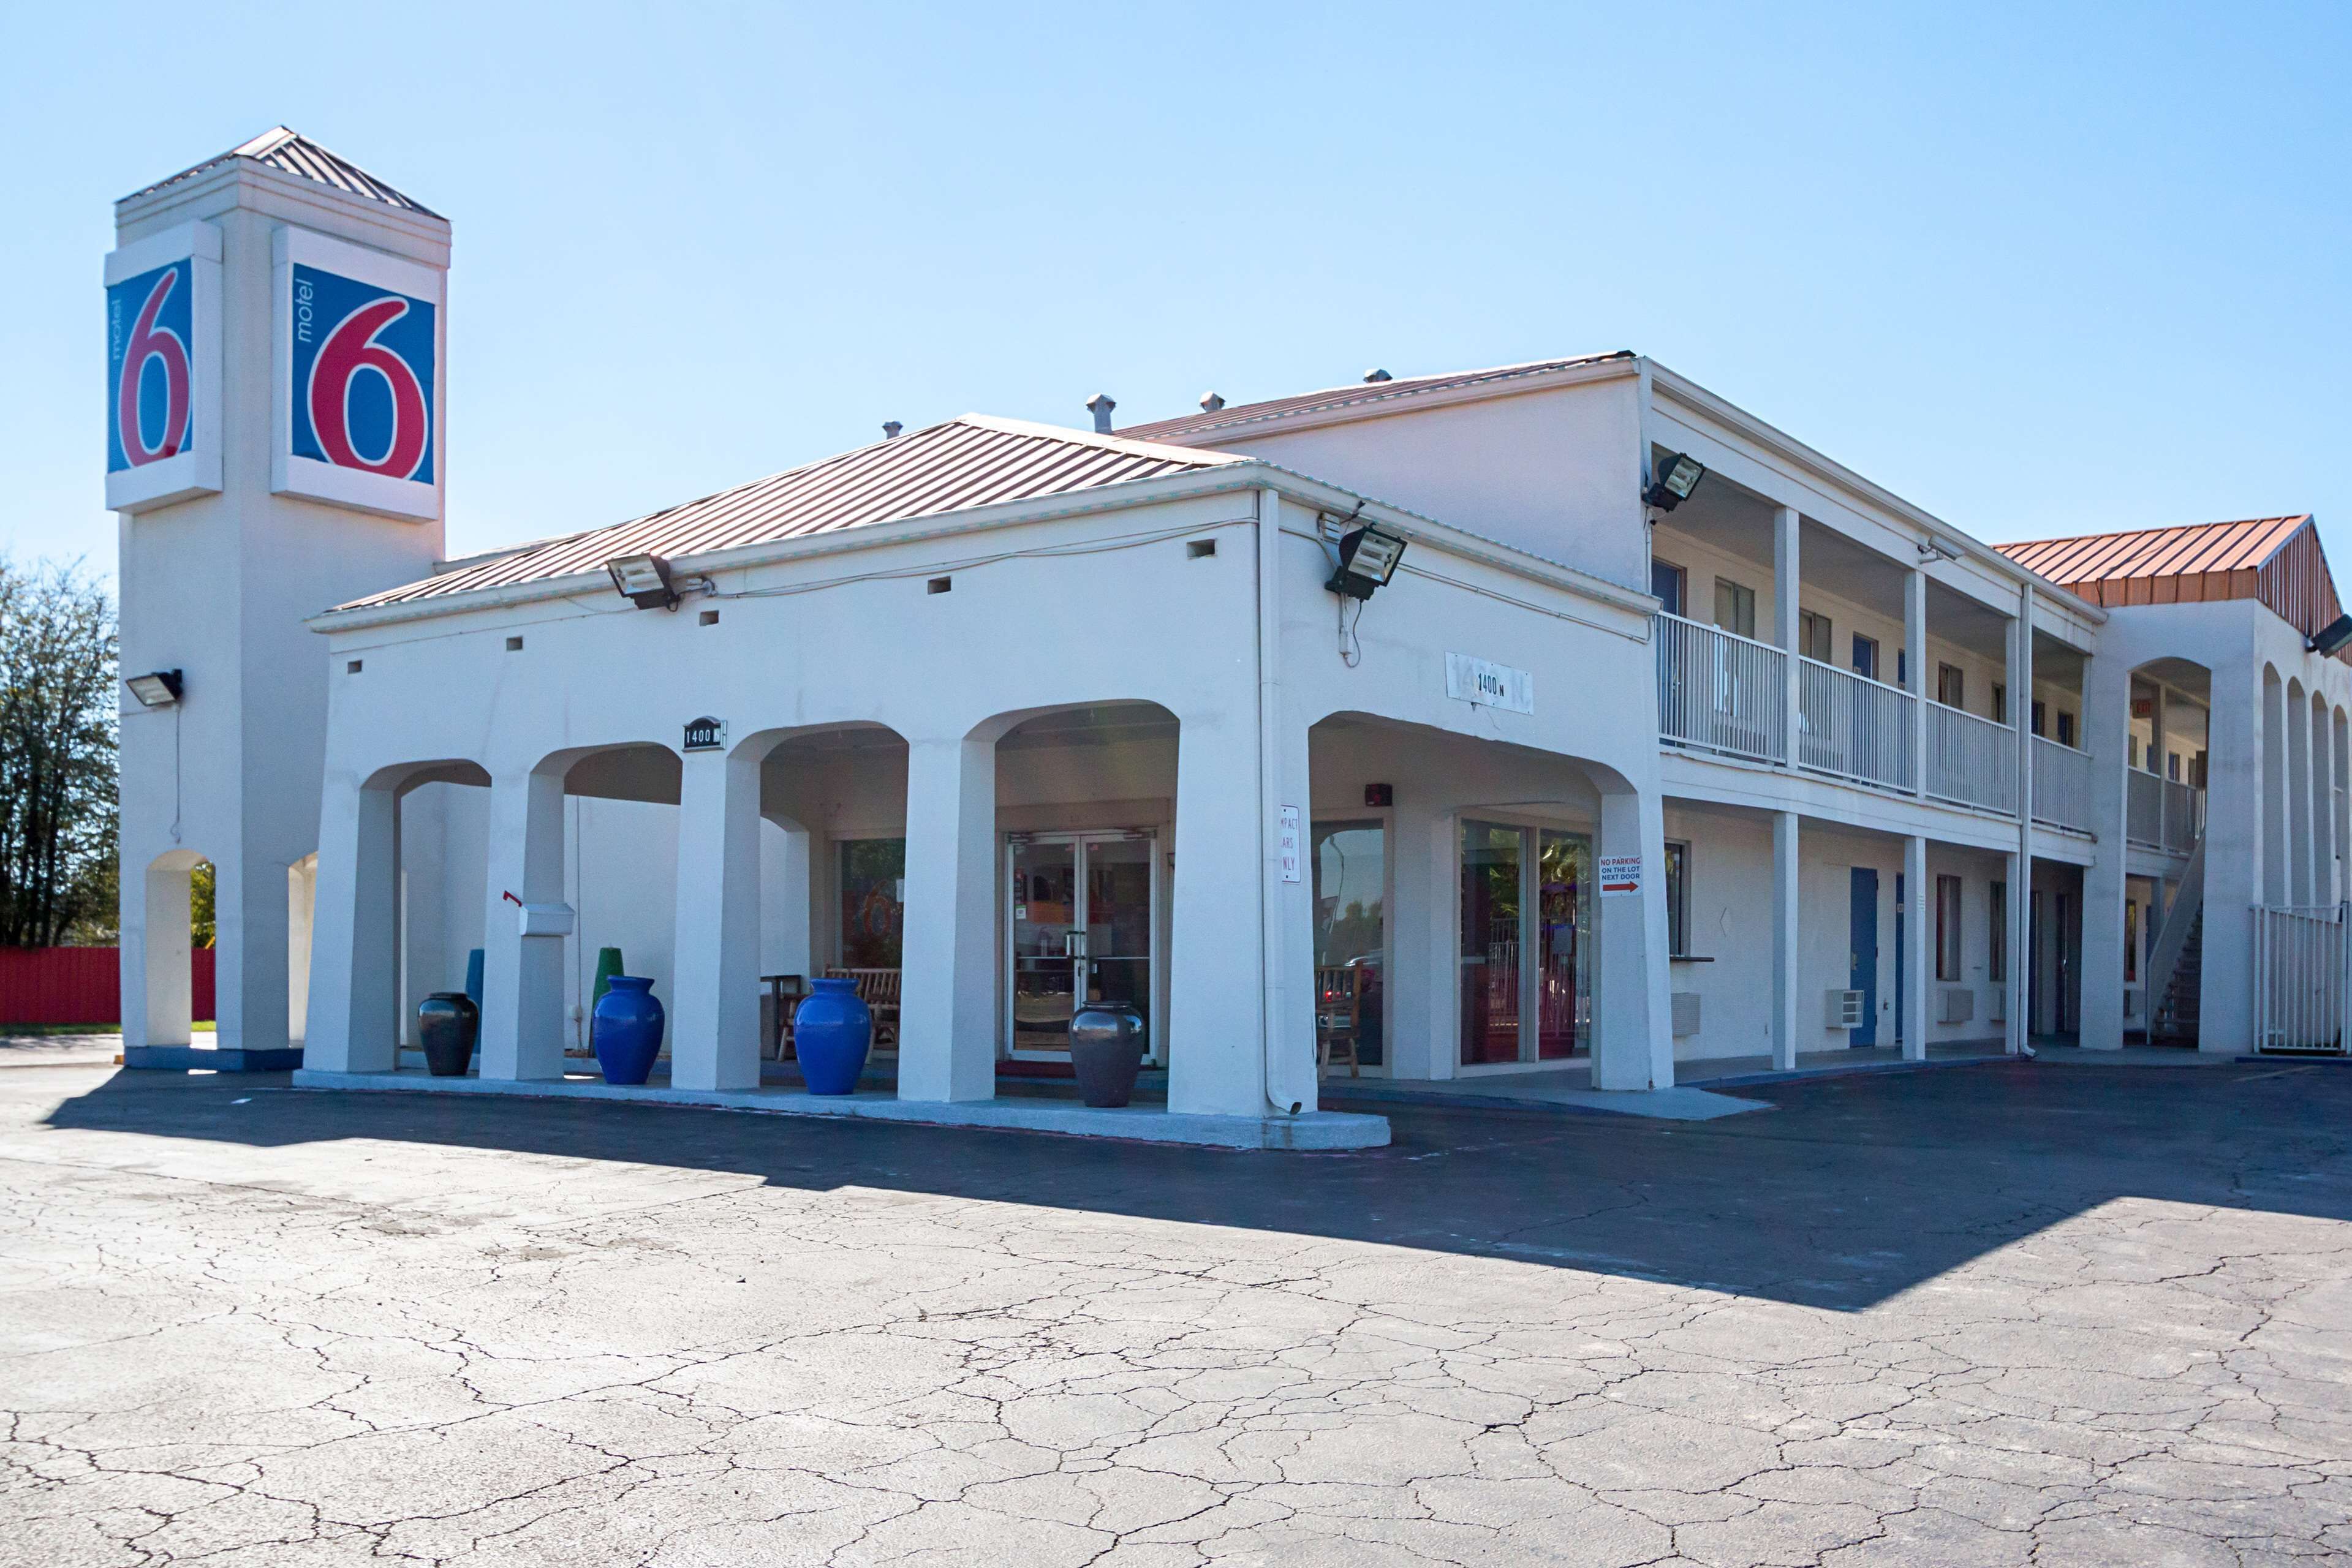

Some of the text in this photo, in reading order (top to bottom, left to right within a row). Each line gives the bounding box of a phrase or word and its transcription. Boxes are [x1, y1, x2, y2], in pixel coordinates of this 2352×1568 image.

[298, 279, 313, 342] motel
[113, 299, 121, 361] motel
[118, 267, 192, 467] 6
[307, 296, 428, 480] 6
[1478, 673, 1504, 696] 1400 N
[687, 729, 710, 743] 1400
[1280, 817, 1298, 830] MPACT
[1282, 837, 1293, 849] ARS
[1282, 857, 1295, 870] NLY
